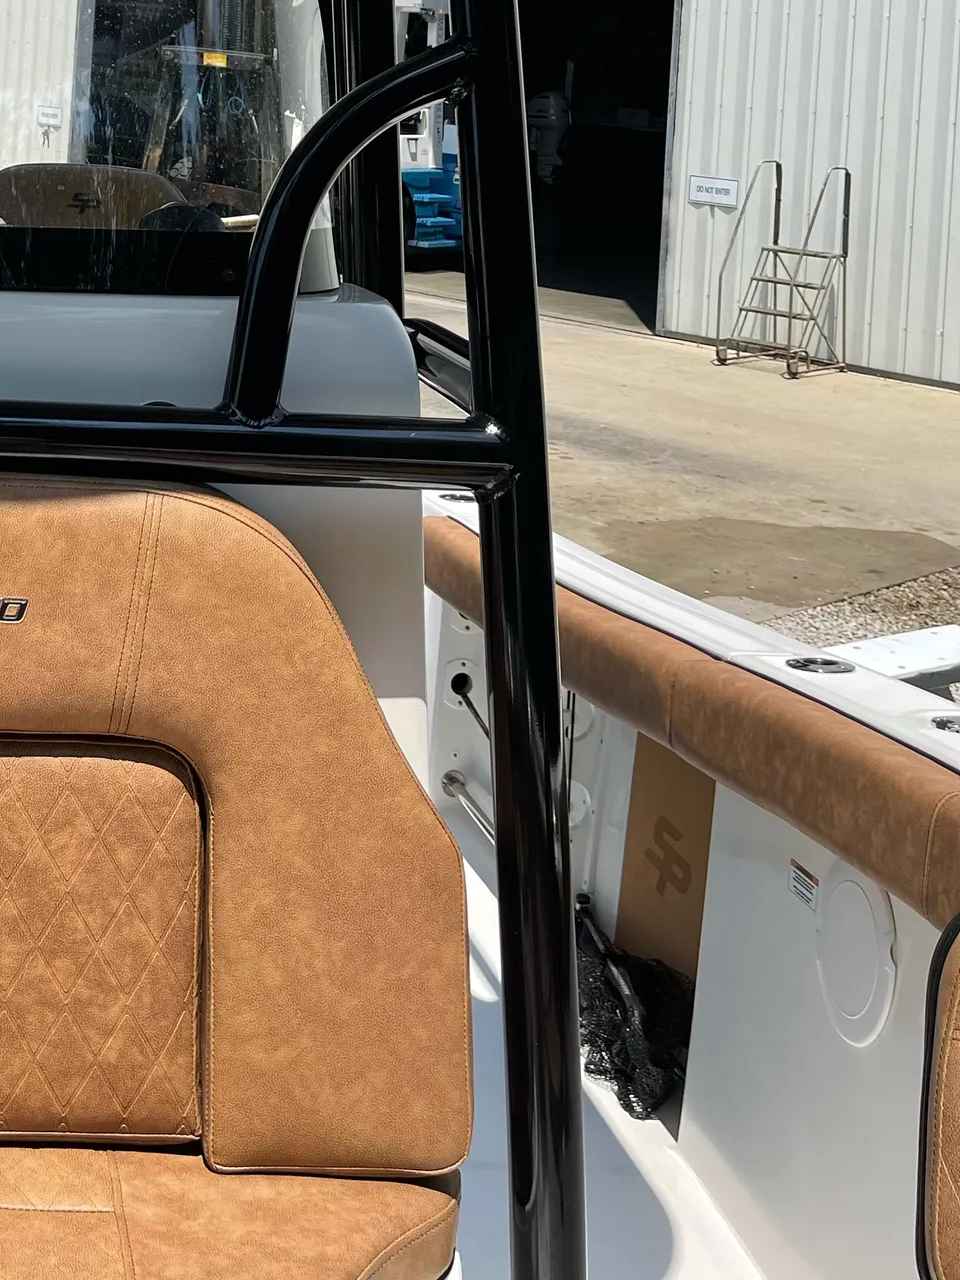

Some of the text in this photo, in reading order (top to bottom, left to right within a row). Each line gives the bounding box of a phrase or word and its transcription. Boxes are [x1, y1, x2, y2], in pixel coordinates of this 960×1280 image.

[696, 184, 731, 196] DO NOT ENTER
